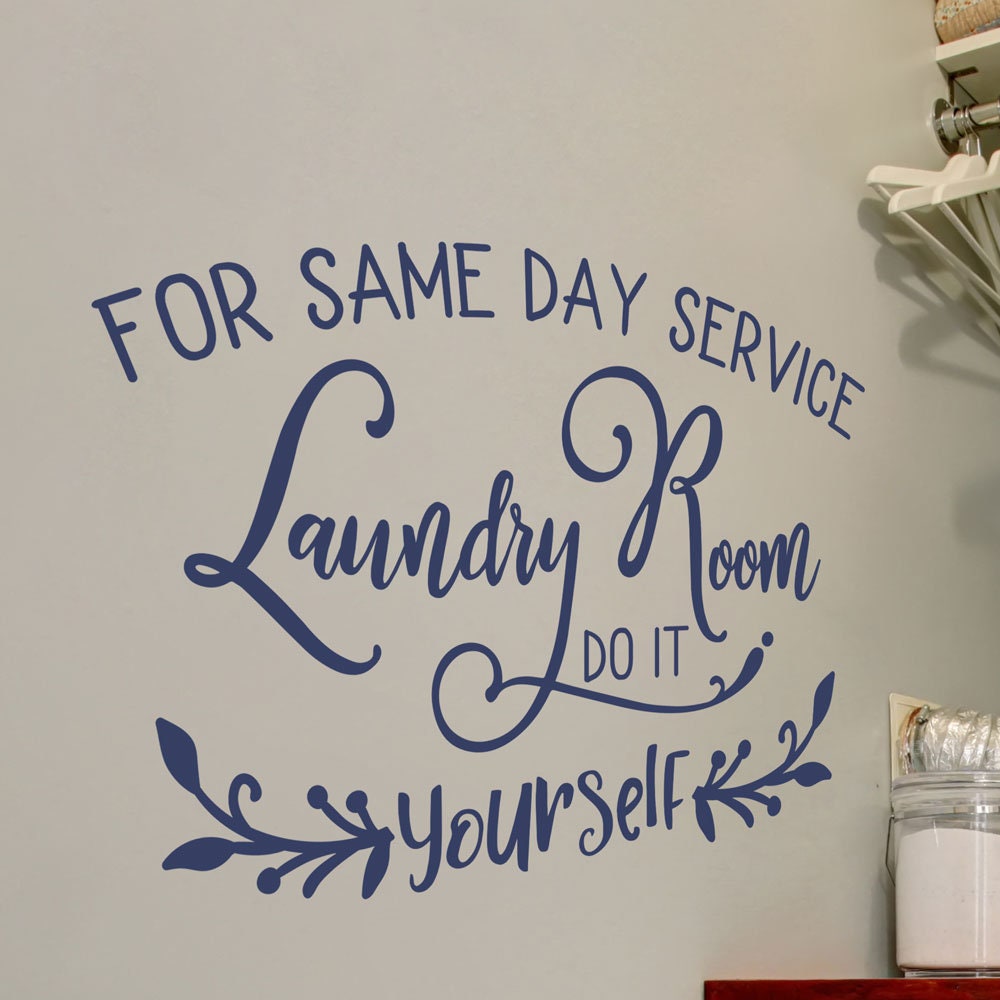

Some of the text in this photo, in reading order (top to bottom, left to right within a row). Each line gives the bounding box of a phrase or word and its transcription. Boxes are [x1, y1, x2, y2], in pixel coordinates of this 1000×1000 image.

[92, 242, 865, 440] FOR SAME DAY SERVICE
[184, 359, 821, 753] Laundry Room
[584, 626, 689, 683] DO IT
